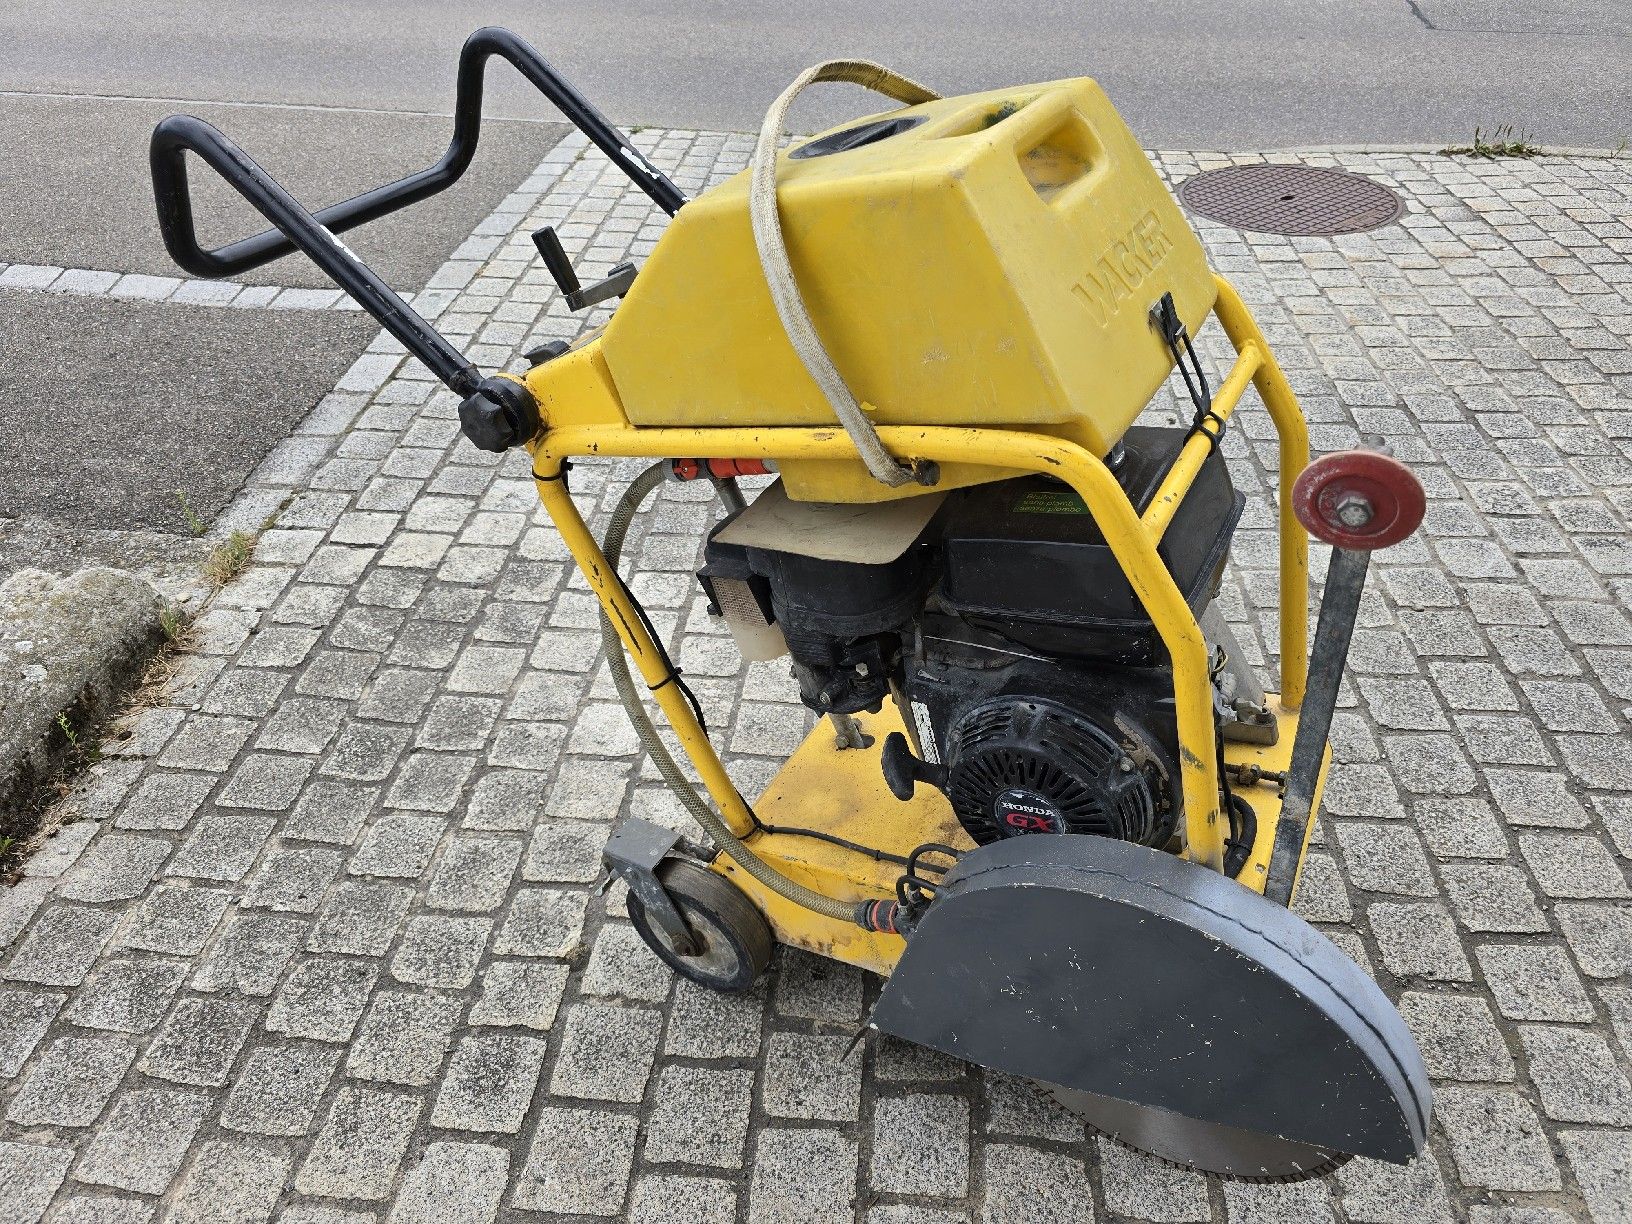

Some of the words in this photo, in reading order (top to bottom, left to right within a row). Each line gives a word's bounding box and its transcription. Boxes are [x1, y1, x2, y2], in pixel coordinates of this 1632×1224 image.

[1071, 209, 1174, 328] WACKER
[1001, 801, 1056, 817] HONDA
[1006, 813, 1054, 833] GX
